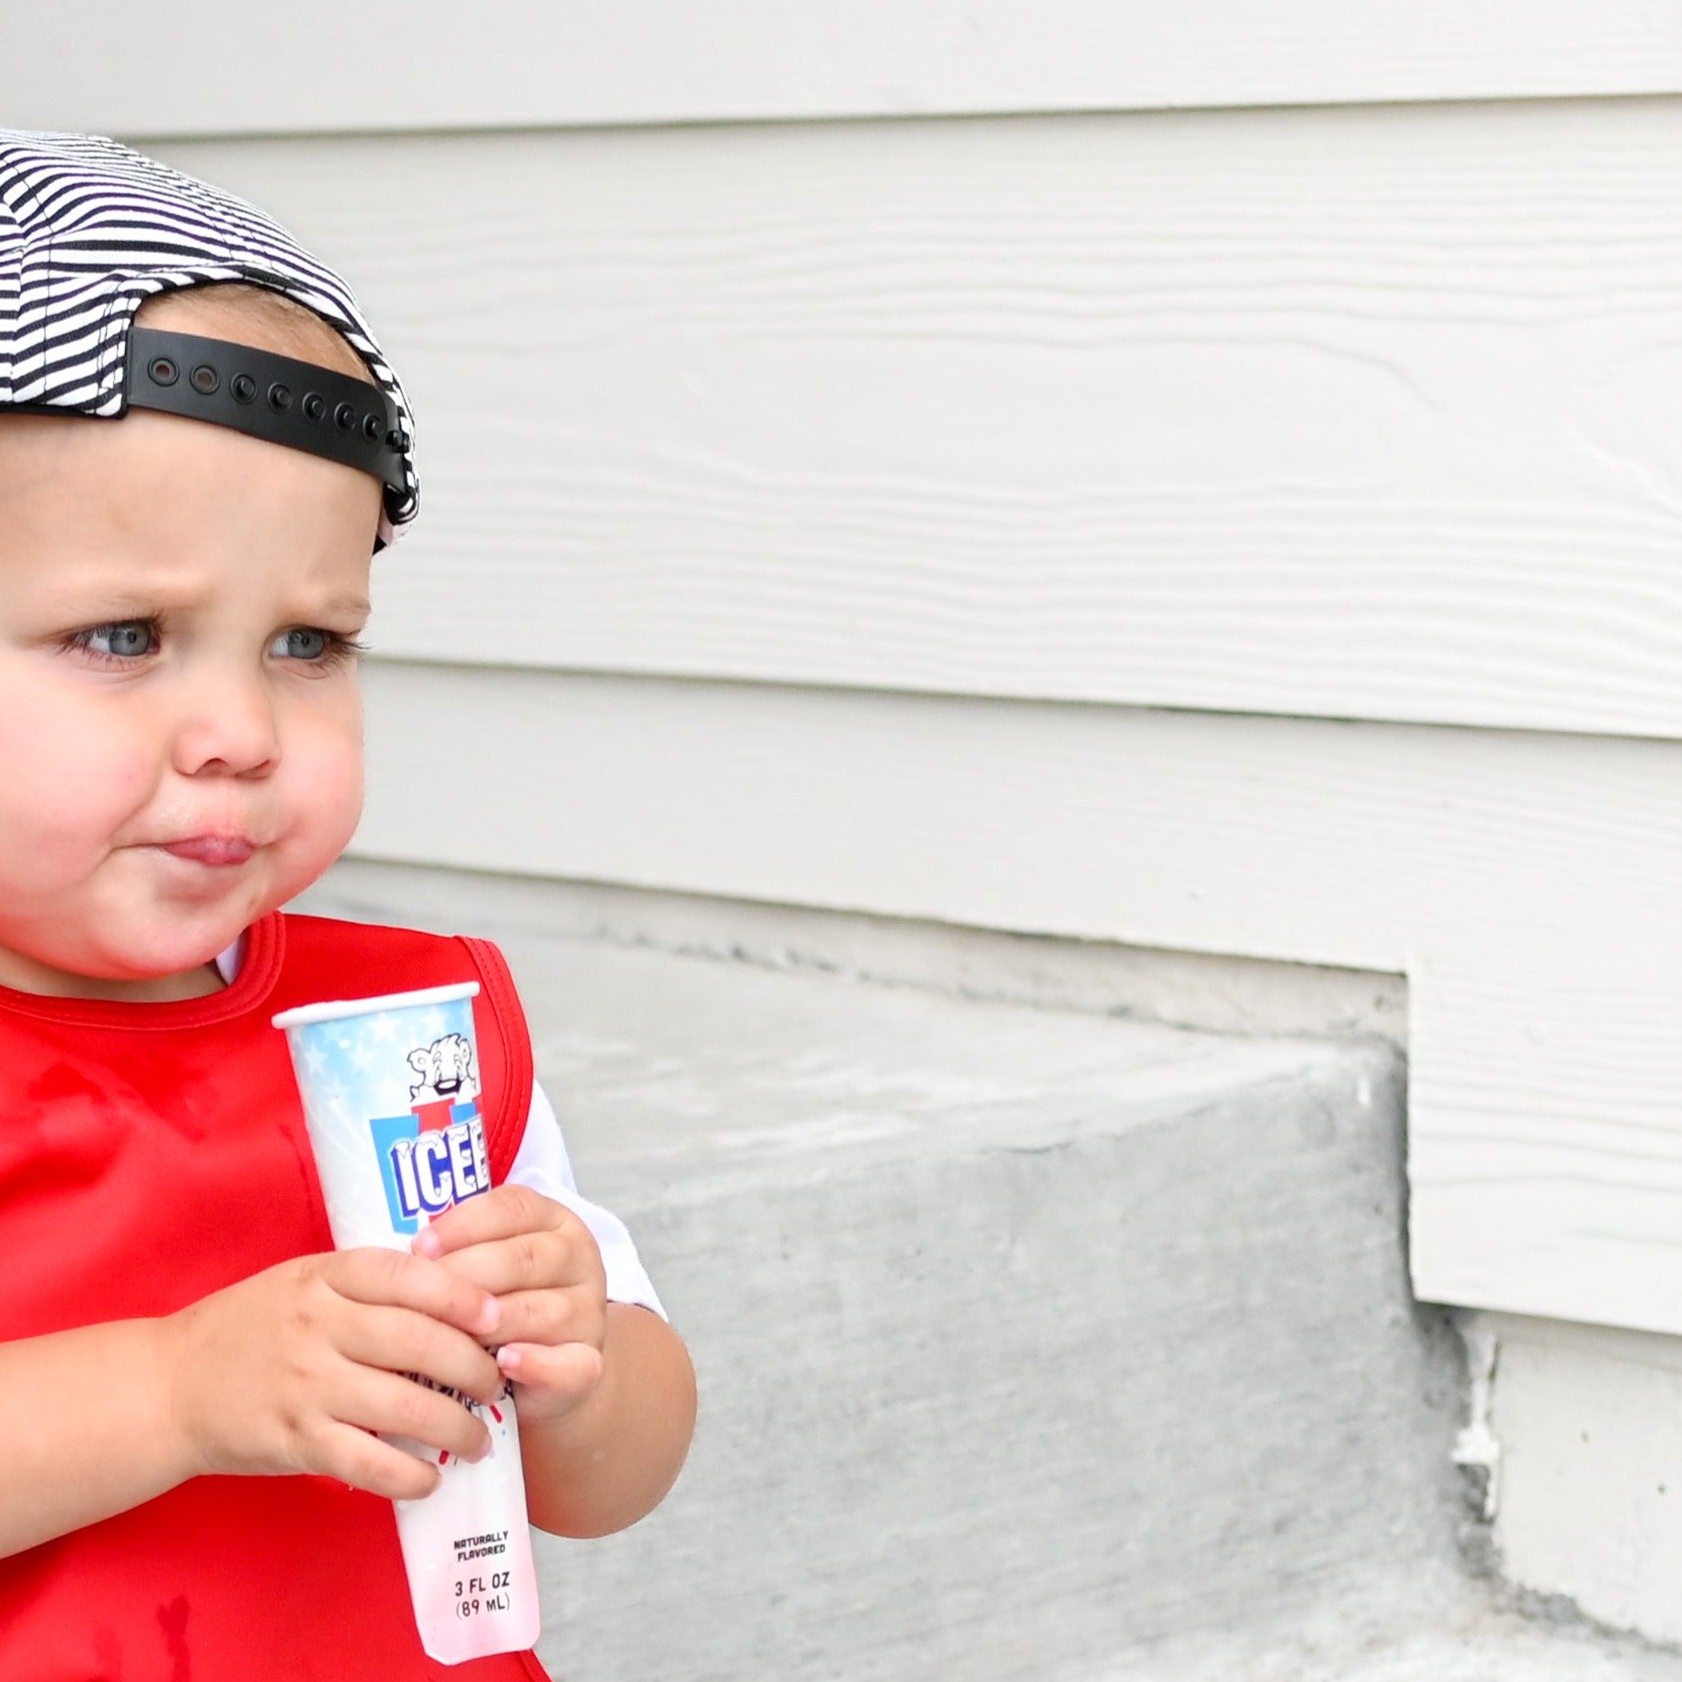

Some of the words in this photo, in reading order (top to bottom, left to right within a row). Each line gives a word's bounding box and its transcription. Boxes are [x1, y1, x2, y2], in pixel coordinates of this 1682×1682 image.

[454, 1531, 508, 1550] NATURALLY
[458, 1544, 505, 1562] FLAVORED
[455, 1581, 463, 1597] 3
[469, 1577, 486, 1594] FL
[492, 1571, 510, 1589] OZ
[456, 1599, 480, 1621] (89
[486, 1592, 510, 1612] ML)
